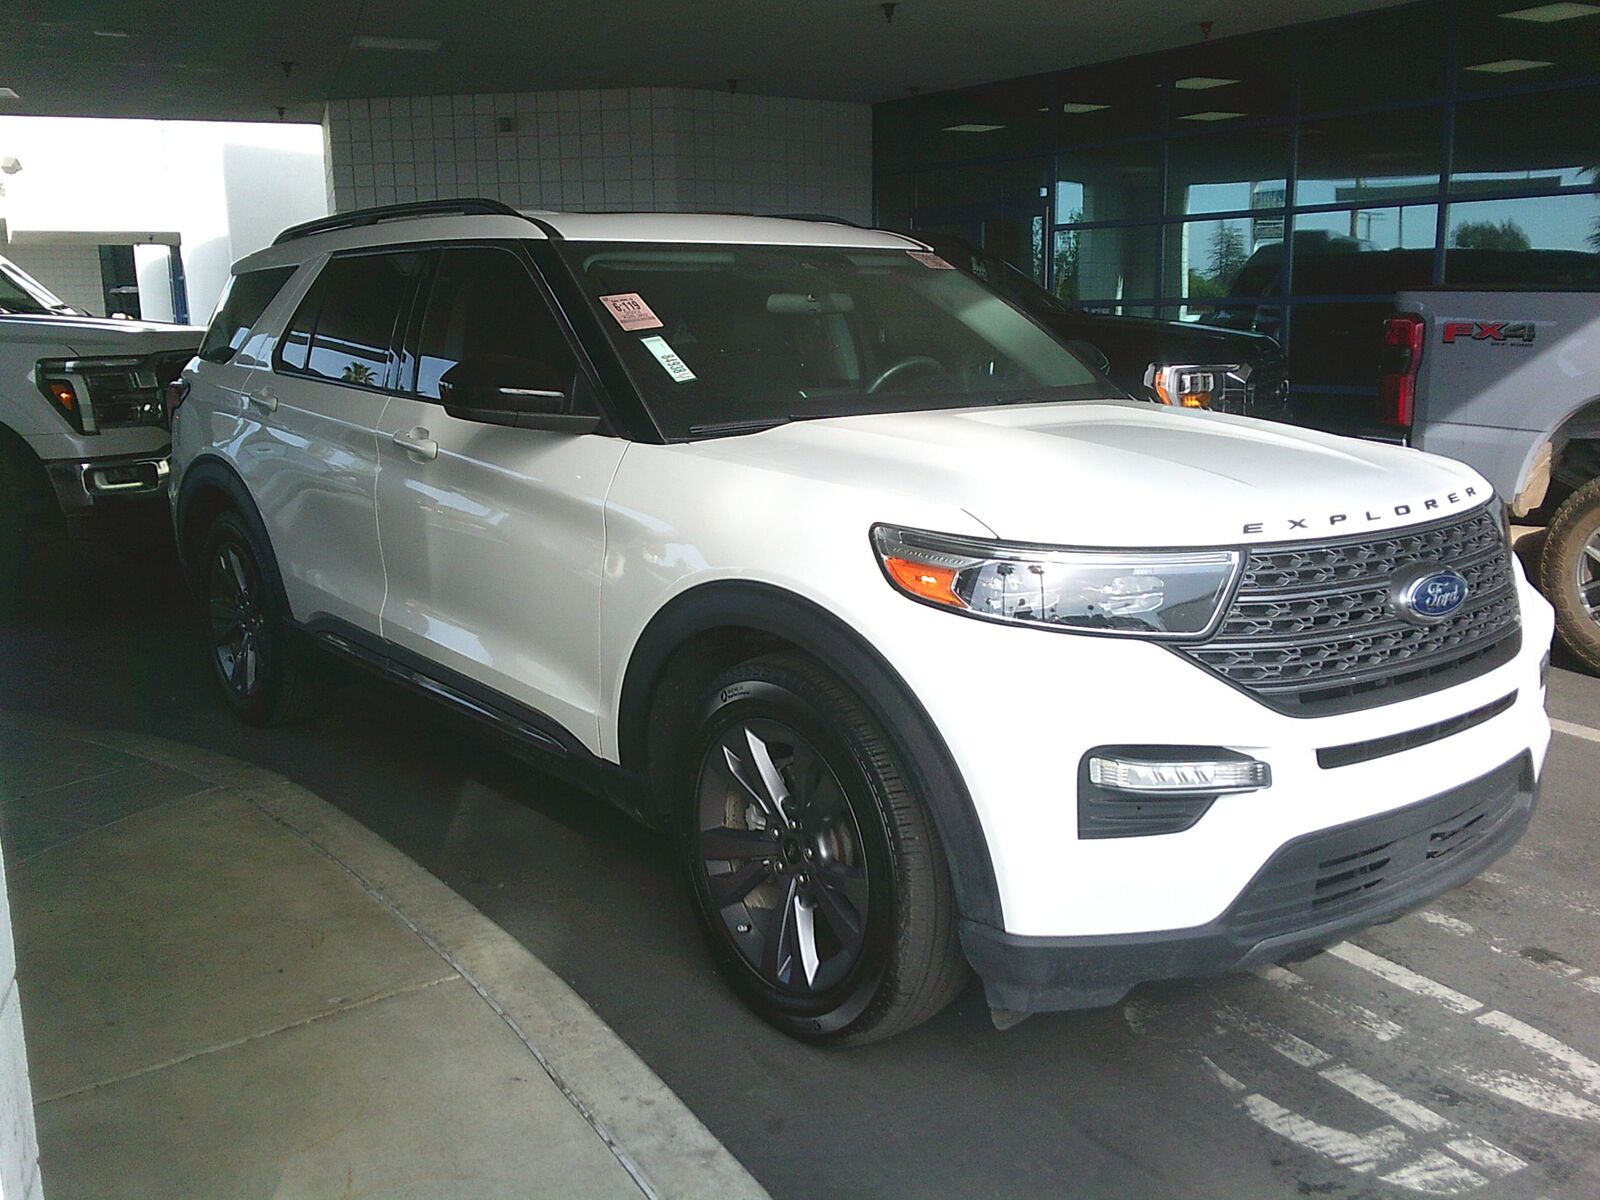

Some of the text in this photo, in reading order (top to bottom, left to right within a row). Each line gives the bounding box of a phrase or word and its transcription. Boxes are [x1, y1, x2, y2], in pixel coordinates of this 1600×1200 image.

[1443, 321, 1535, 343] FX4
[1242, 486, 1477, 534] EXPLORER
[1426, 581, 1459, 609] Ford
